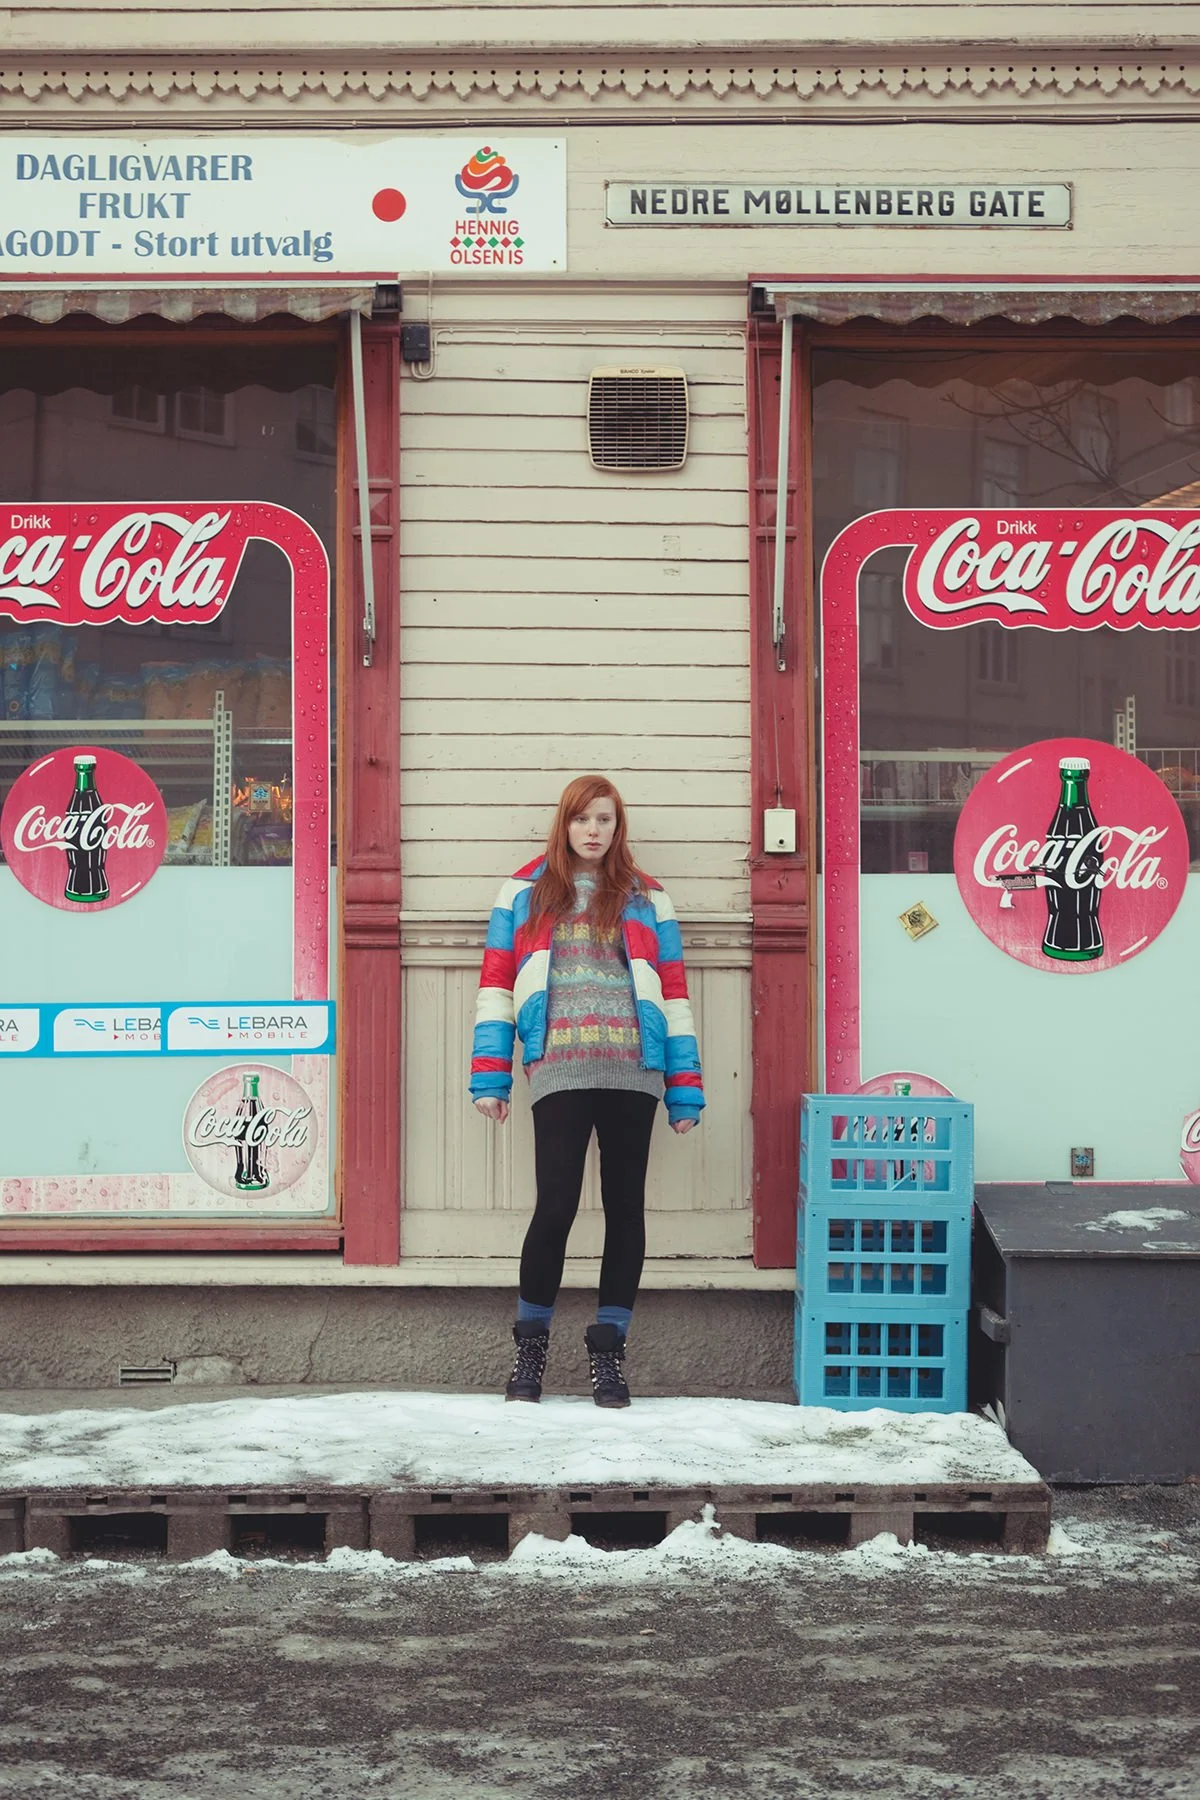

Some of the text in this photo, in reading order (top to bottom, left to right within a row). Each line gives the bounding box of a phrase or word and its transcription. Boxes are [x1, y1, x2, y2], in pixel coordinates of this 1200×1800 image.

[15, 153, 254, 182] DAGLIGVARER
[78, 192, 192, 219] FRUKT
[630, 188, 1046, 218] NEDRE MØLLENBERG GATE
[455, 219, 519, 235] HENNIG
[134, 229, 220, 257] Stort
[230, 229, 334, 263] utvalg
[450, 249, 524, 265] OLSEN IS
[10, 514, 52, 530] Drikk
[996, 520, 1038, 536] Drikk
[917, 516, 1200, 616] Coca-Cola
[13, 800, 155, 852] Coca-Cola
[973, 824, 1169, 890] Coca-Cola
[227, 1016, 308, 1030] LEBARA
[239, 1031, 308, 1039] MOBILE
